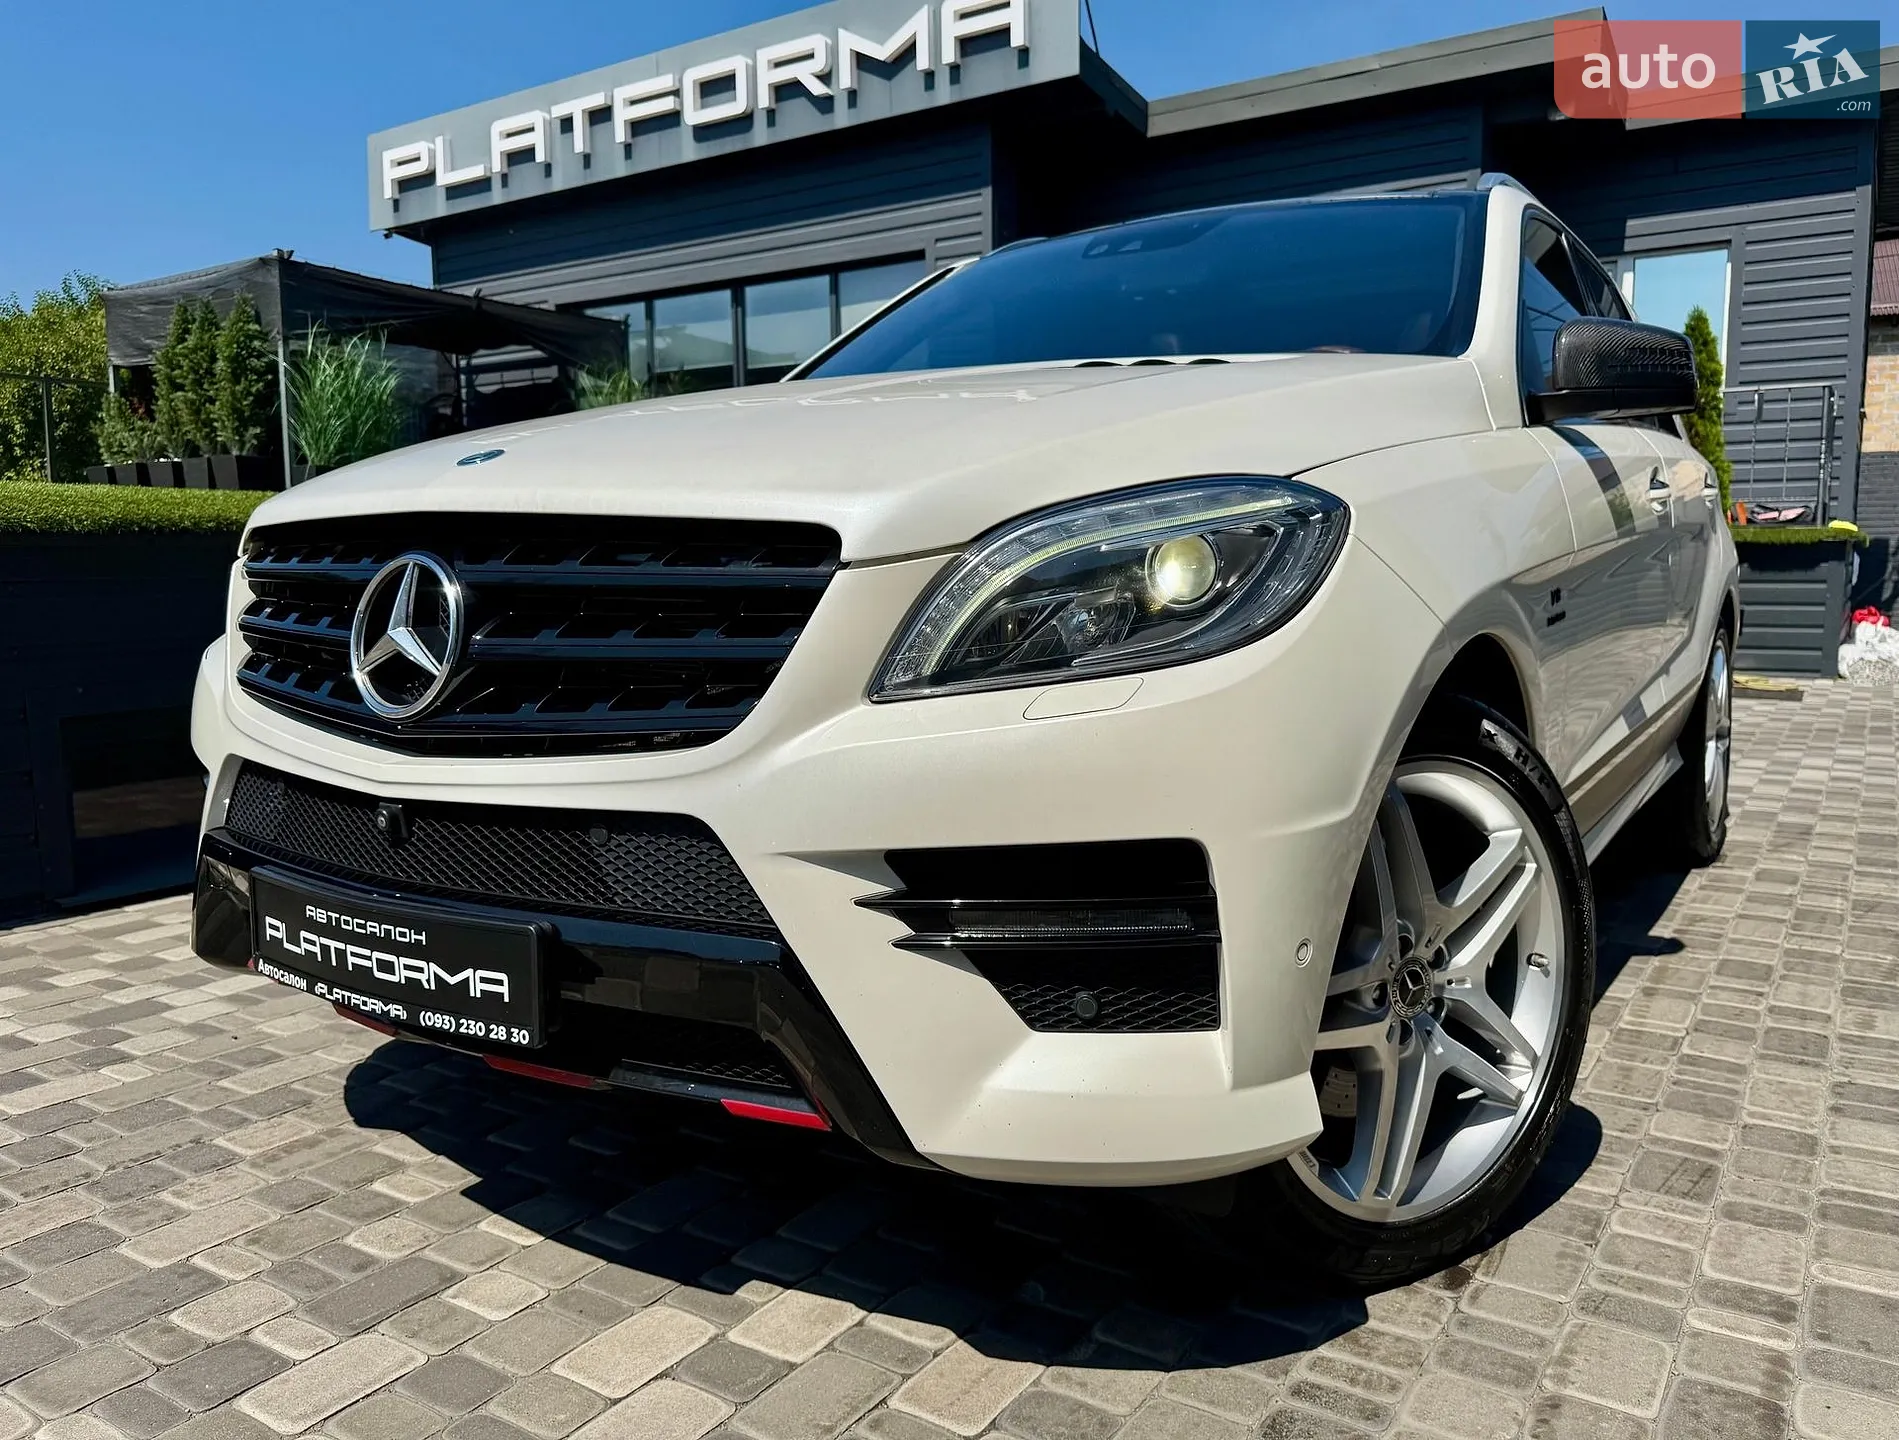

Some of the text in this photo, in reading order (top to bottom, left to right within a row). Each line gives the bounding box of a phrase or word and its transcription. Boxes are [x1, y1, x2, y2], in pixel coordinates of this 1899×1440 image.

[382, 0, 1030, 200] PLATFORMA
[264, 915, 510, 1003] PLATFORMA
[306, 904, 426, 946] АВТОСАЛОН
[257, 958, 307, 992] Автосалон
[419, 1010, 456, 1033] (093)
[458, 1018, 486, 1037] 230
[488, 1023, 507, 1041] 28
[510, 1027, 530, 1045] 30
